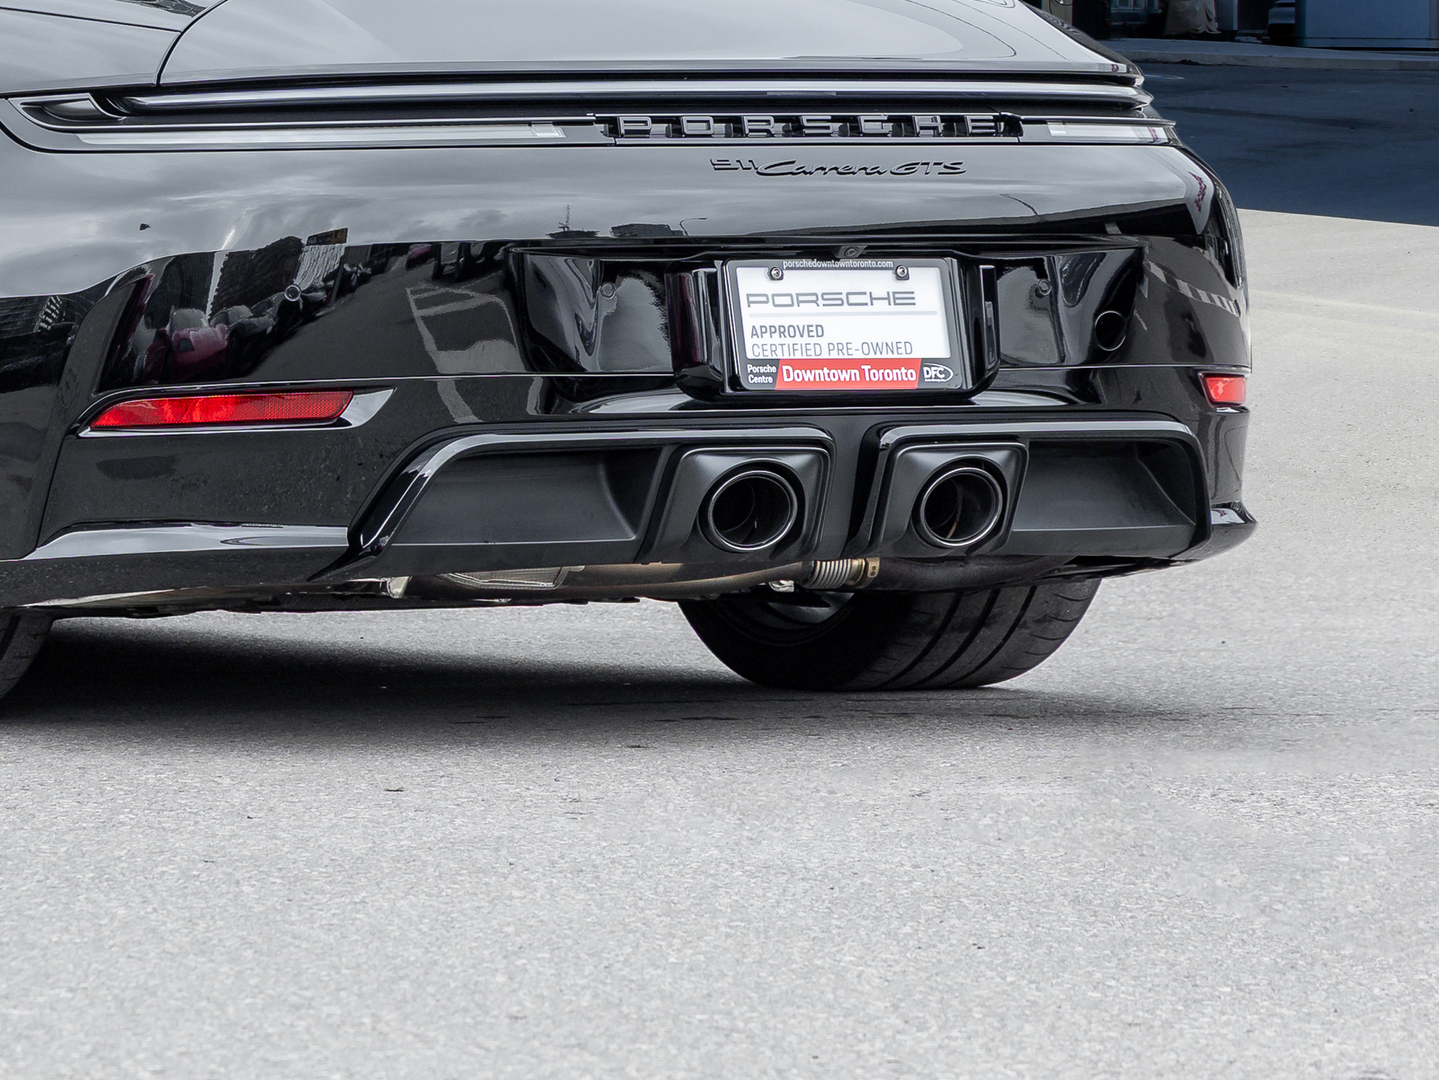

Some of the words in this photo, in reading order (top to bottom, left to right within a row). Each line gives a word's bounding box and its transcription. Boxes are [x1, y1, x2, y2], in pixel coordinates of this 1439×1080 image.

[617, 114, 998, 139] PORSCHE
[710, 158, 759, 171] 911
[756, 159, 888, 177] Carrera
[889, 161, 967, 176] GTS
[783, 259, 894, 270] porschedowntowntoronto.com
[746, 291, 916, 308] PORSCHE
[750, 324, 825, 339] APPROVED
[751, 343, 823, 358] CERTIFIED
[827, 341, 913, 356] PRE-OWNED
[747, 364, 777, 374] Porsche
[782, 365, 861, 383] Downtown
[861, 365, 917, 382] Toronto
[923, 366, 945, 379] DFC
[748, 374, 773, 384] Centre
